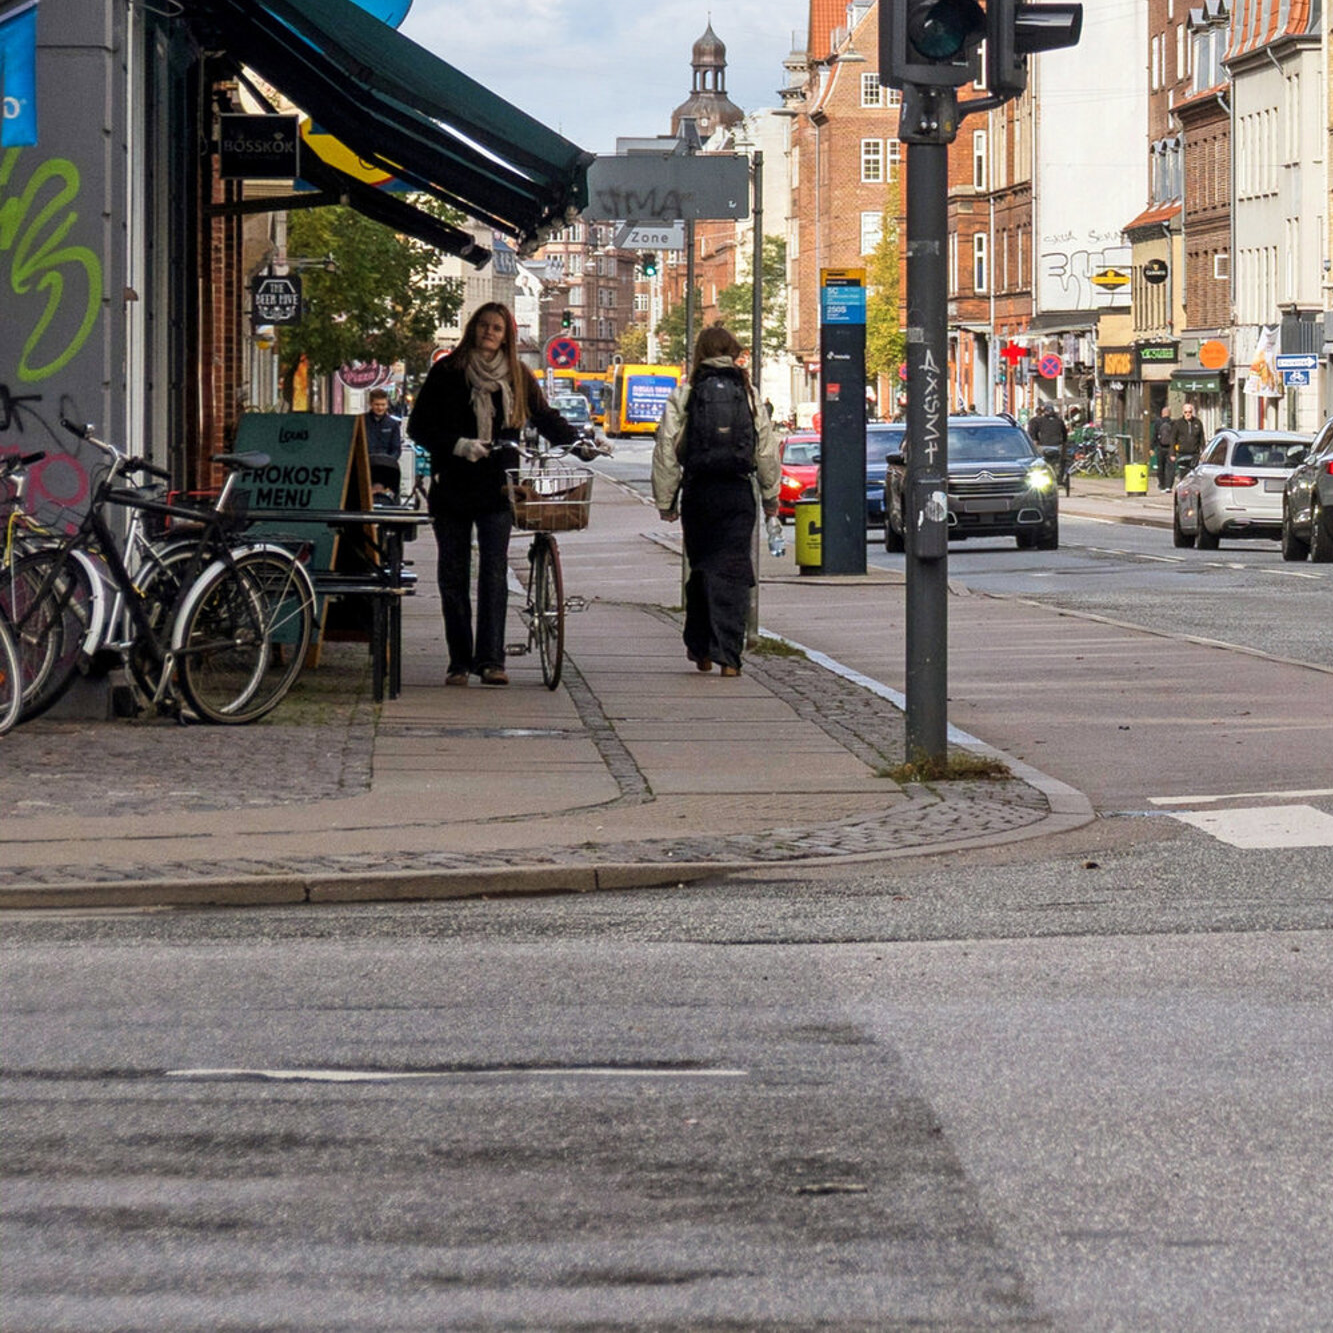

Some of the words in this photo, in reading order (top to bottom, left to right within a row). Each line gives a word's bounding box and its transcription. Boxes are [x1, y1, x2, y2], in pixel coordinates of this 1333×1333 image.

[631, 231, 669, 244] Zone
[241, 466, 335, 486] FROKOST
[256, 487, 312, 507] MENU
